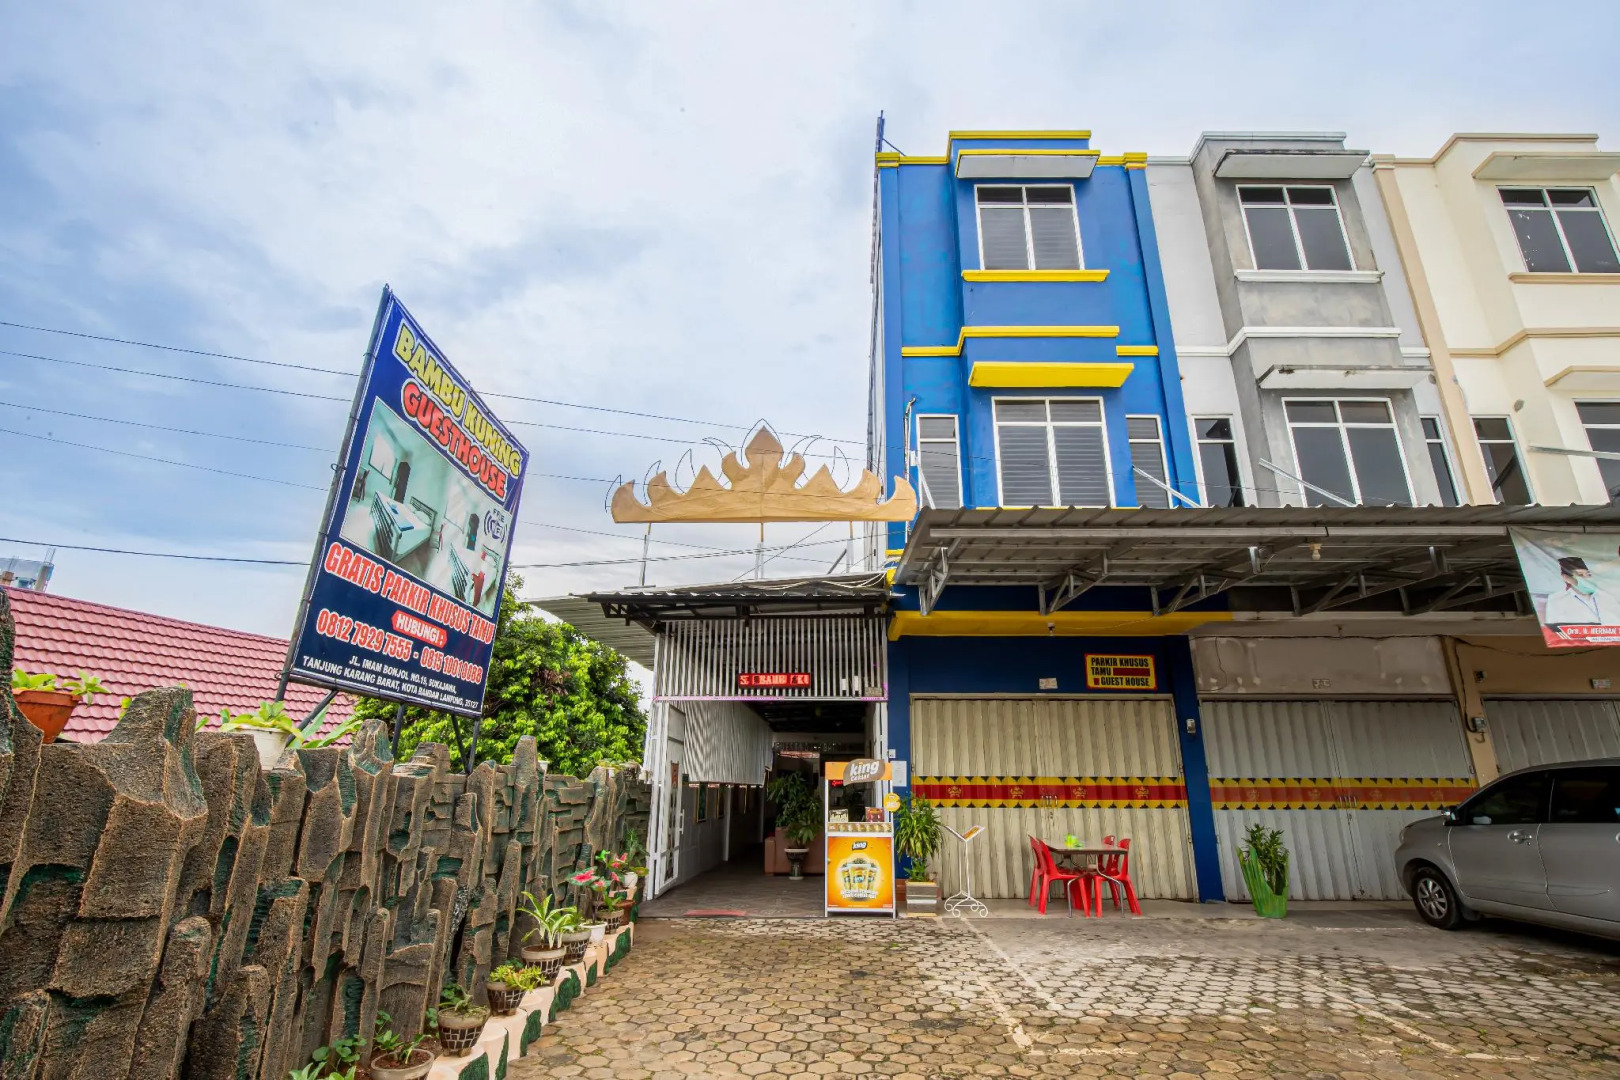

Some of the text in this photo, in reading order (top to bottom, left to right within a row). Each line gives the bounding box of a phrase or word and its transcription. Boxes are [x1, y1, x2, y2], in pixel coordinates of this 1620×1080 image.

[394, 322, 522, 477] BAMBU KUNING
[403, 381, 507, 498] GUESTHOUSE
[324, 541, 496, 645] GRATIS PARKIR KHUSUS TAMU
[316, 608, 353, 642] 0812
[351, 621, 384, 653] 7929
[382, 632, 414, 662] 7555
[420, 646, 444, 672] 0815
[302, 655, 343, 676] TANJUNG
[343, 667, 376, 685] KARANG
[376, 675, 400, 692] BARAT,
[402, 680, 418, 694] KOTA
[348, 655, 360, 667] JL.
[362, 658, 382, 673] IMAM
[382, 664, 409, 680] BONJOL
[1091, 657, 1149, 668] PARKIR KHUSUS
[1091, 667, 1111, 676] TAMU
[1100, 677, 1150, 686] GUEST HOUSE
[849, 761, 880, 777] king
